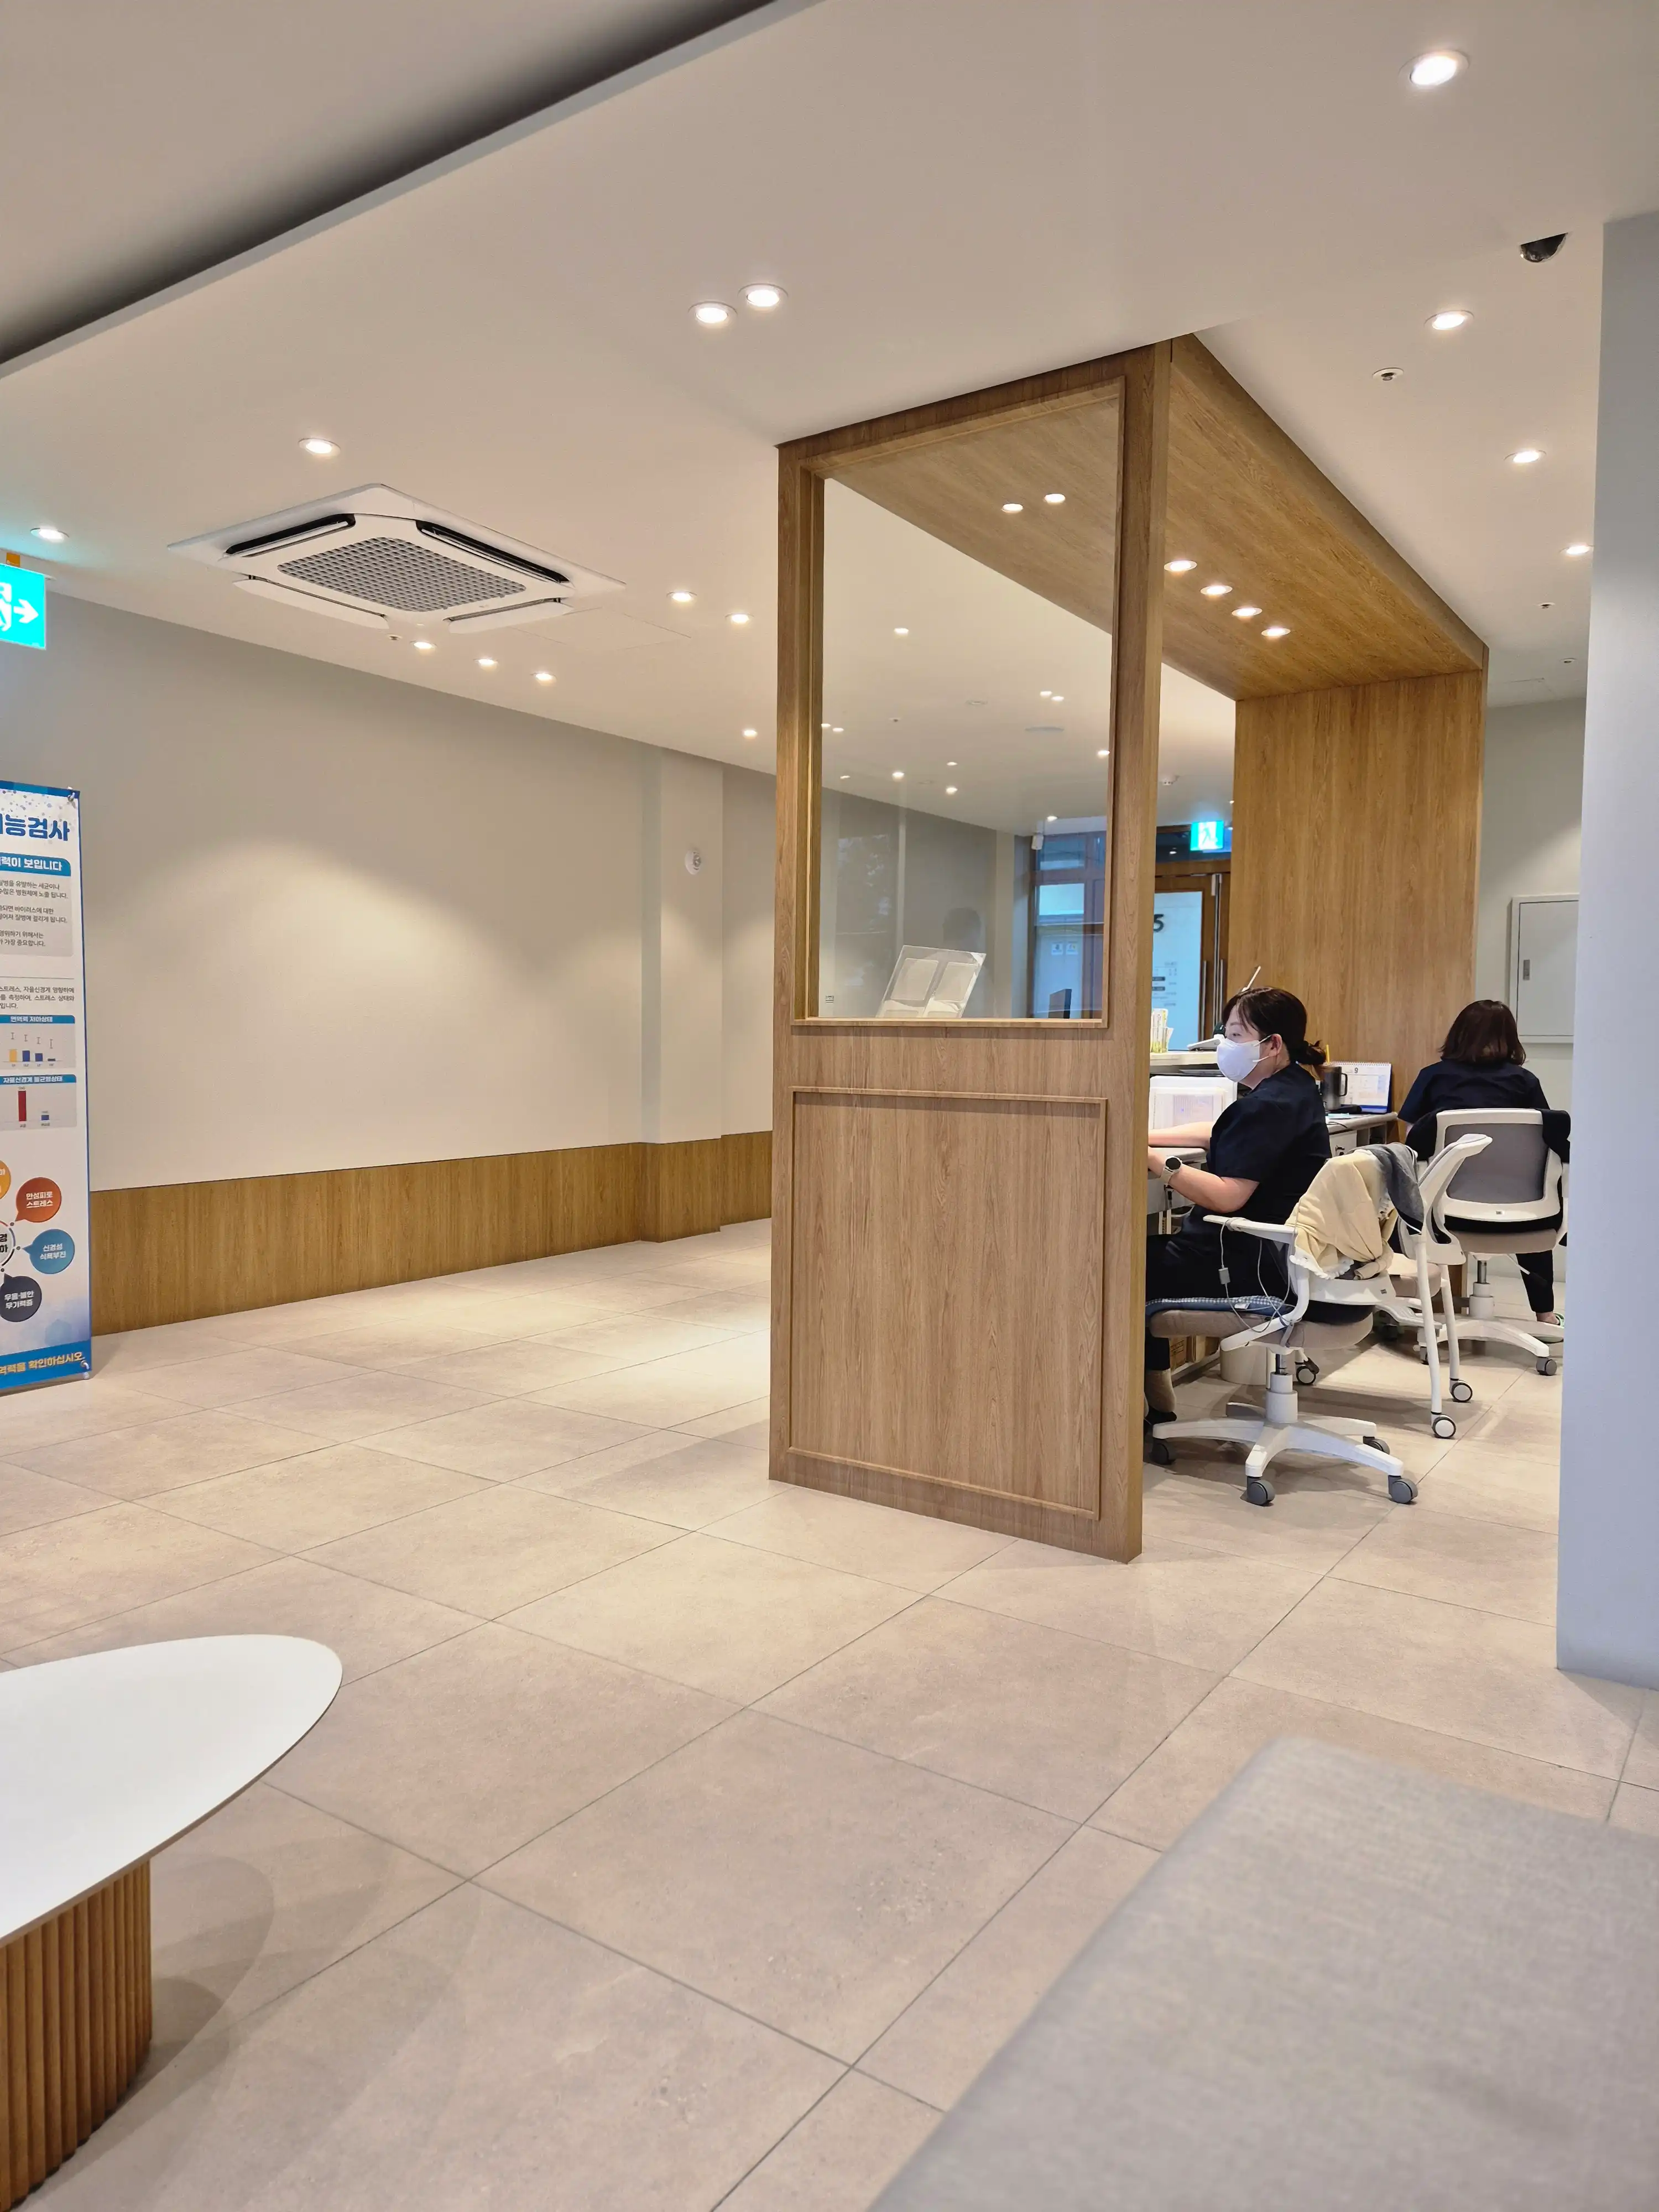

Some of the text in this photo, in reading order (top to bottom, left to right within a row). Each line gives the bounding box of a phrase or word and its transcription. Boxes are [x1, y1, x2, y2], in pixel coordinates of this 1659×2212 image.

[0, 813, 70, 841] 능검사
[0, 856, 62, 871] 력이 보입니다
[26, 1191, 53, 1200] 만성피로
[27, 1199, 54, 1208] 스트레스
